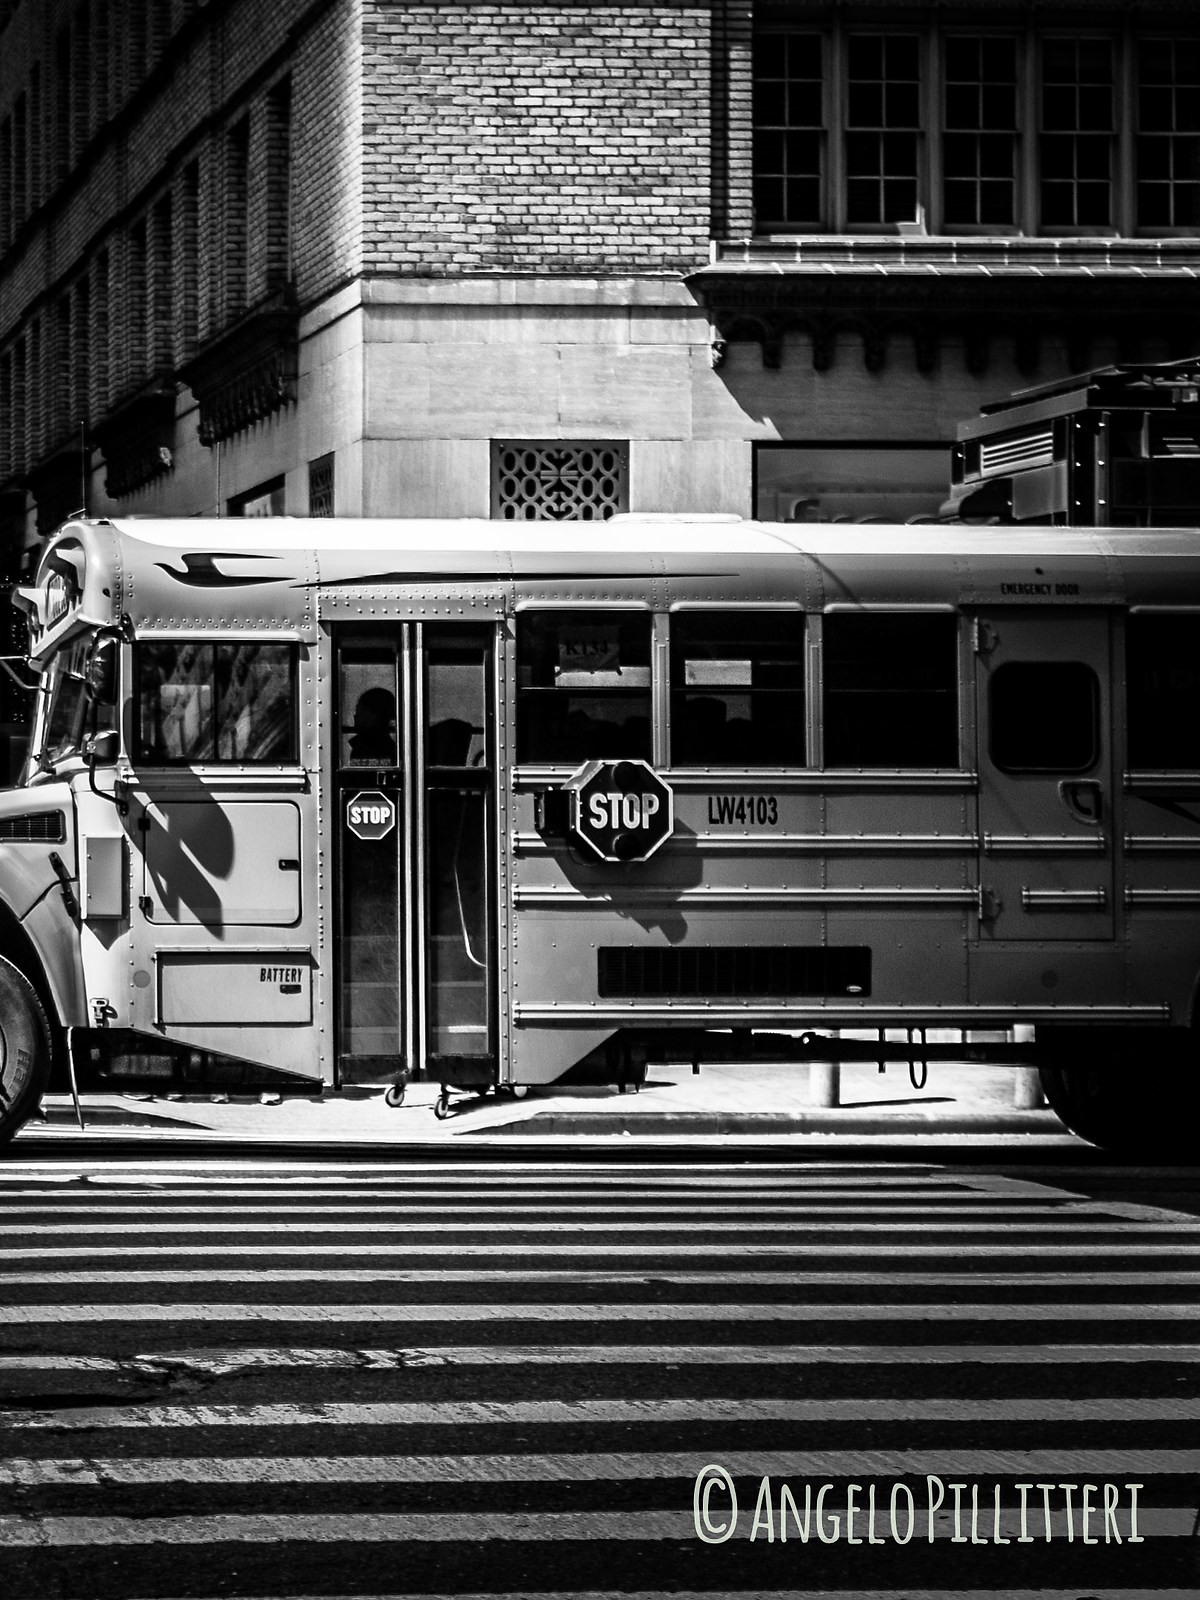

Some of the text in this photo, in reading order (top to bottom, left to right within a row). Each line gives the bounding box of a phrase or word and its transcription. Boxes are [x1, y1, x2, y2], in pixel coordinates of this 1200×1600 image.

[1001, 583, 1080, 596] EMERGENCY DOOR
[351, 806, 391, 824] STOP
[589, 793, 660, 829] STOP
[708, 797, 778, 825] LW4103
[260, 968, 303, 982] BATTERY
